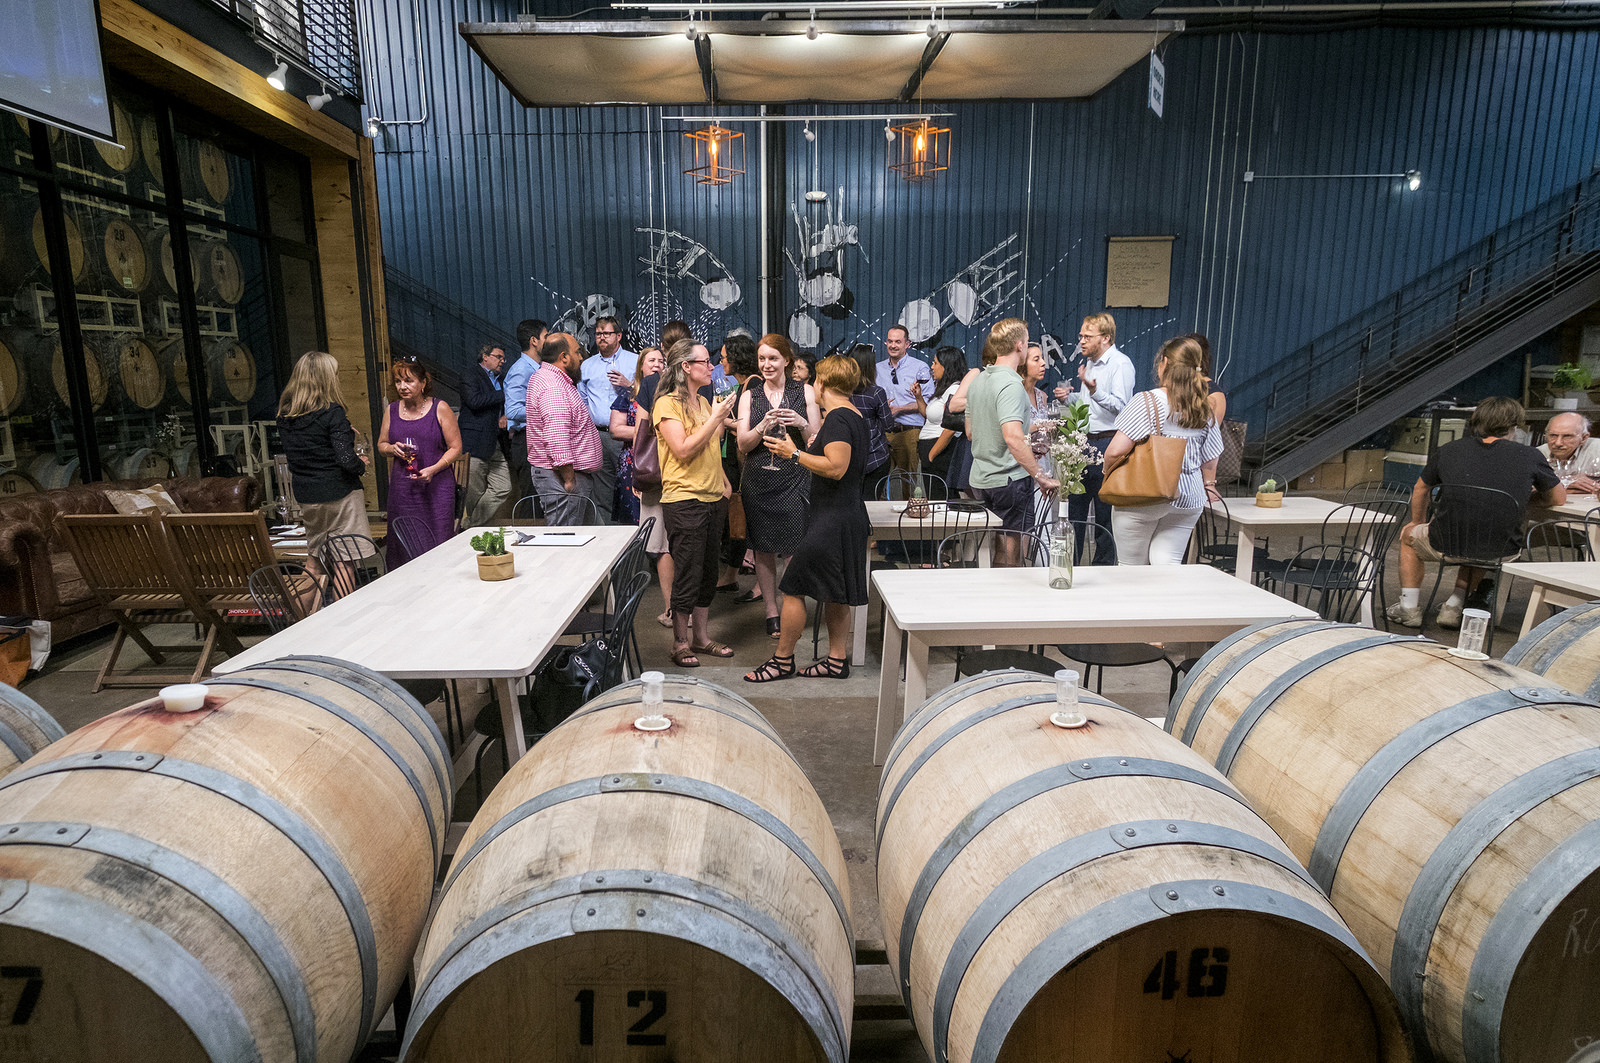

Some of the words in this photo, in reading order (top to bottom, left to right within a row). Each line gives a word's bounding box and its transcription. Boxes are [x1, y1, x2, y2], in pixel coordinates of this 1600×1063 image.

[129, 346, 140, 358] 34
[2, 480, 16, 494] 40
[1, 966, 43, 1025] 7
[1143, 947, 1230, 1000] 46
[574, 989, 667, 1046] 12
